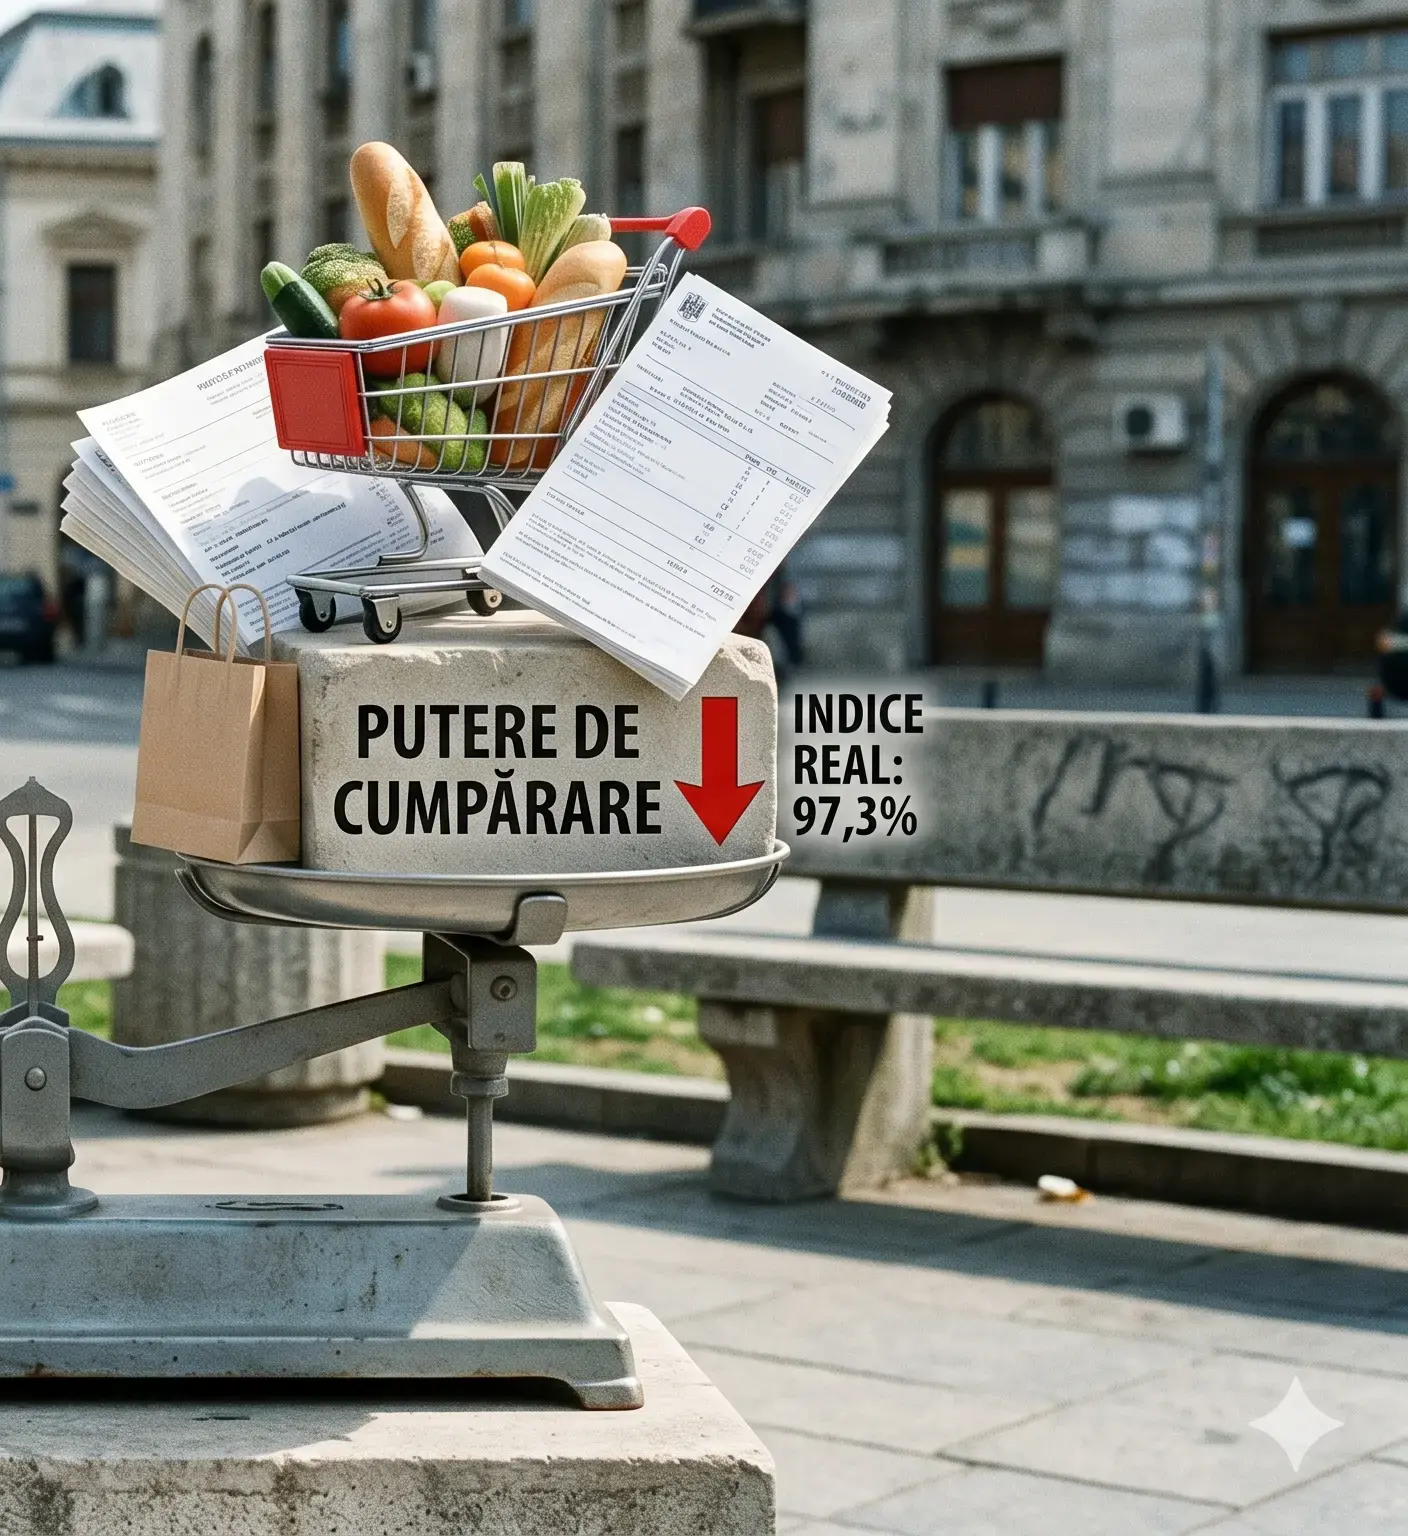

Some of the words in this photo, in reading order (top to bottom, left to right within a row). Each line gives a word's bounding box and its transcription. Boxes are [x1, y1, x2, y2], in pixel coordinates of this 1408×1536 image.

[357, 704, 557, 759] PUTERE
[575, 704, 640, 759] DE
[334, 768, 662, 836] CUMPĂRARE
